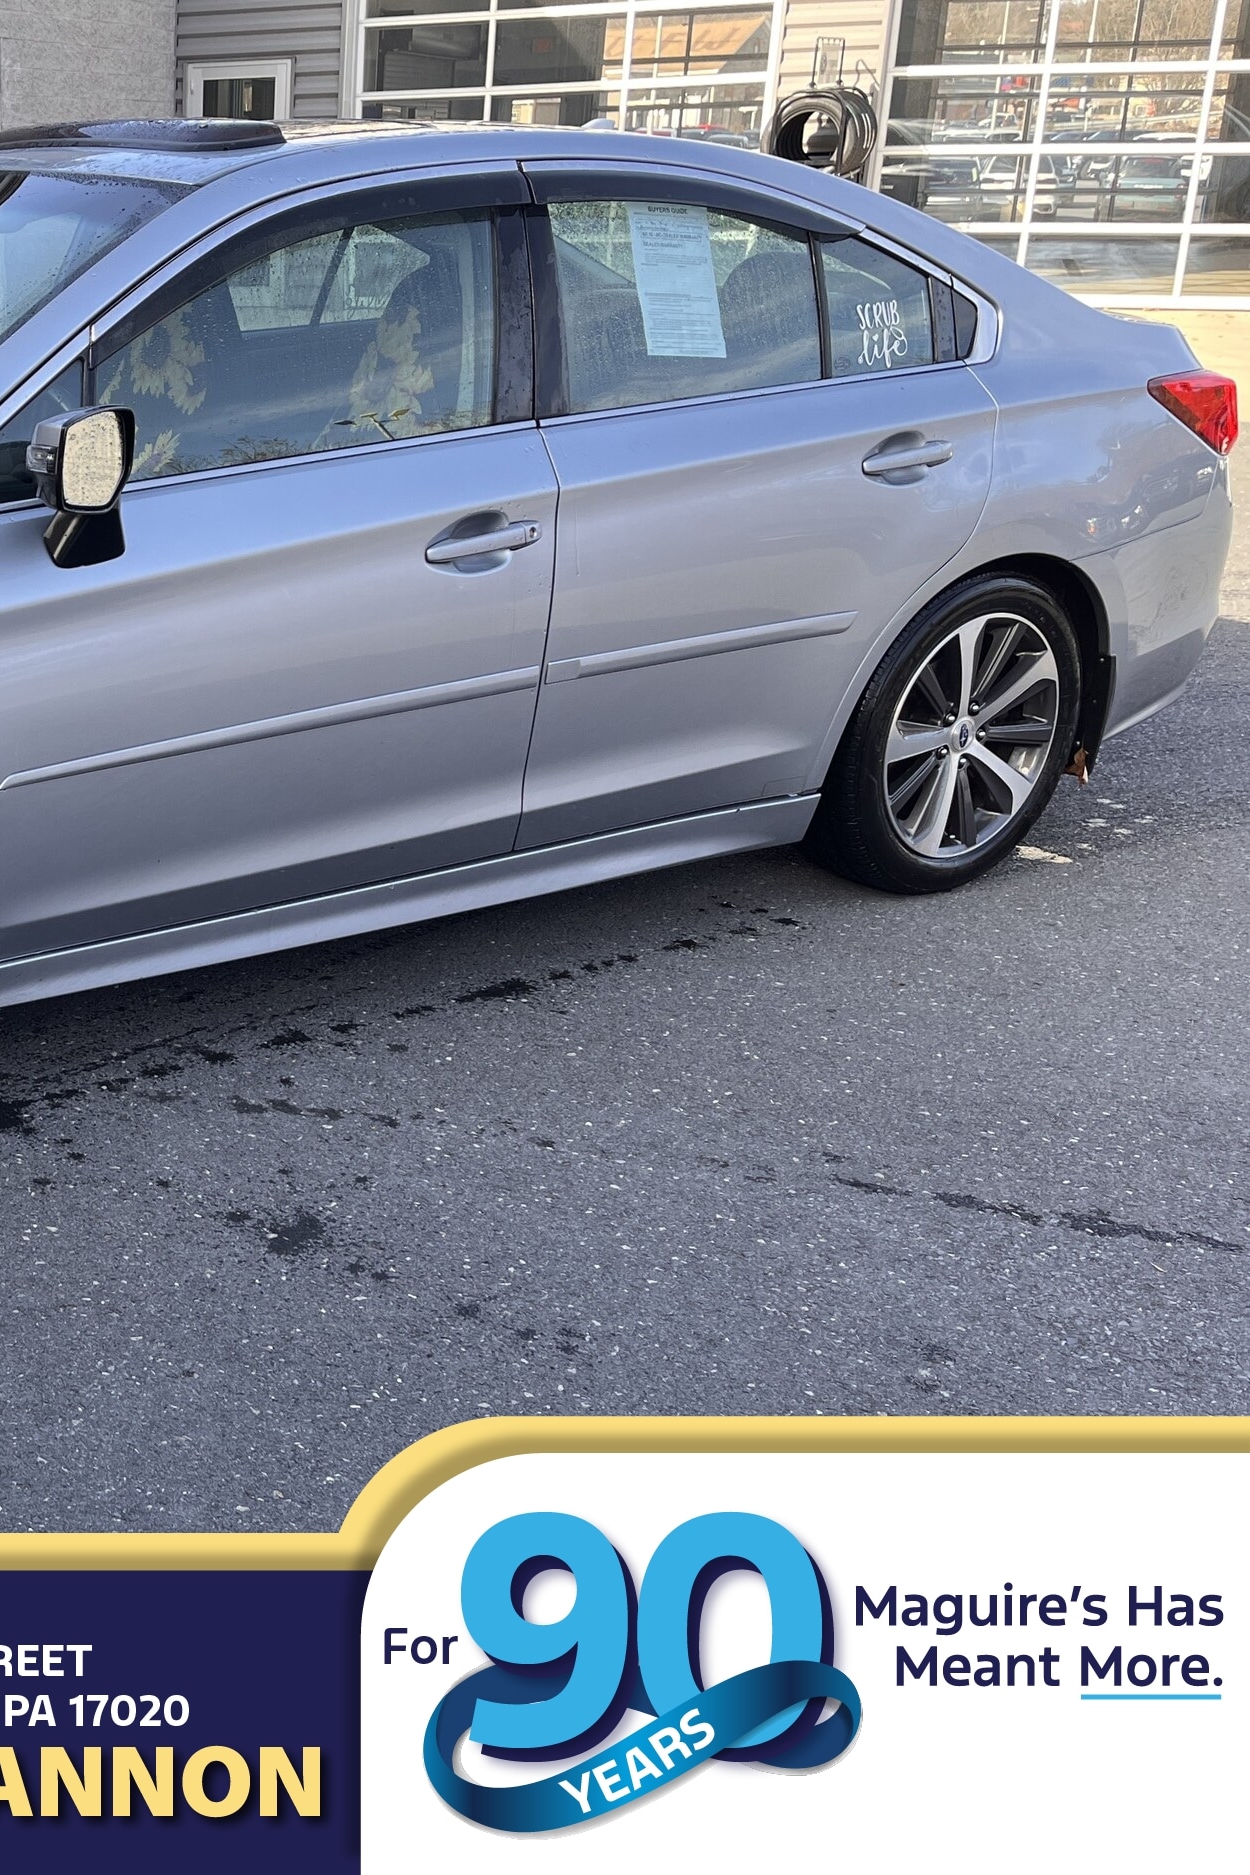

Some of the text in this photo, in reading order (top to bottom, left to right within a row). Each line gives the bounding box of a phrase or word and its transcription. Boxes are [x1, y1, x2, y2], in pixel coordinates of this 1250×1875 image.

[647, 205, 688, 215] BUYERS GUIDE
[856, 299, 900, 330] SCRUB
[857, 326, 908, 369] life
